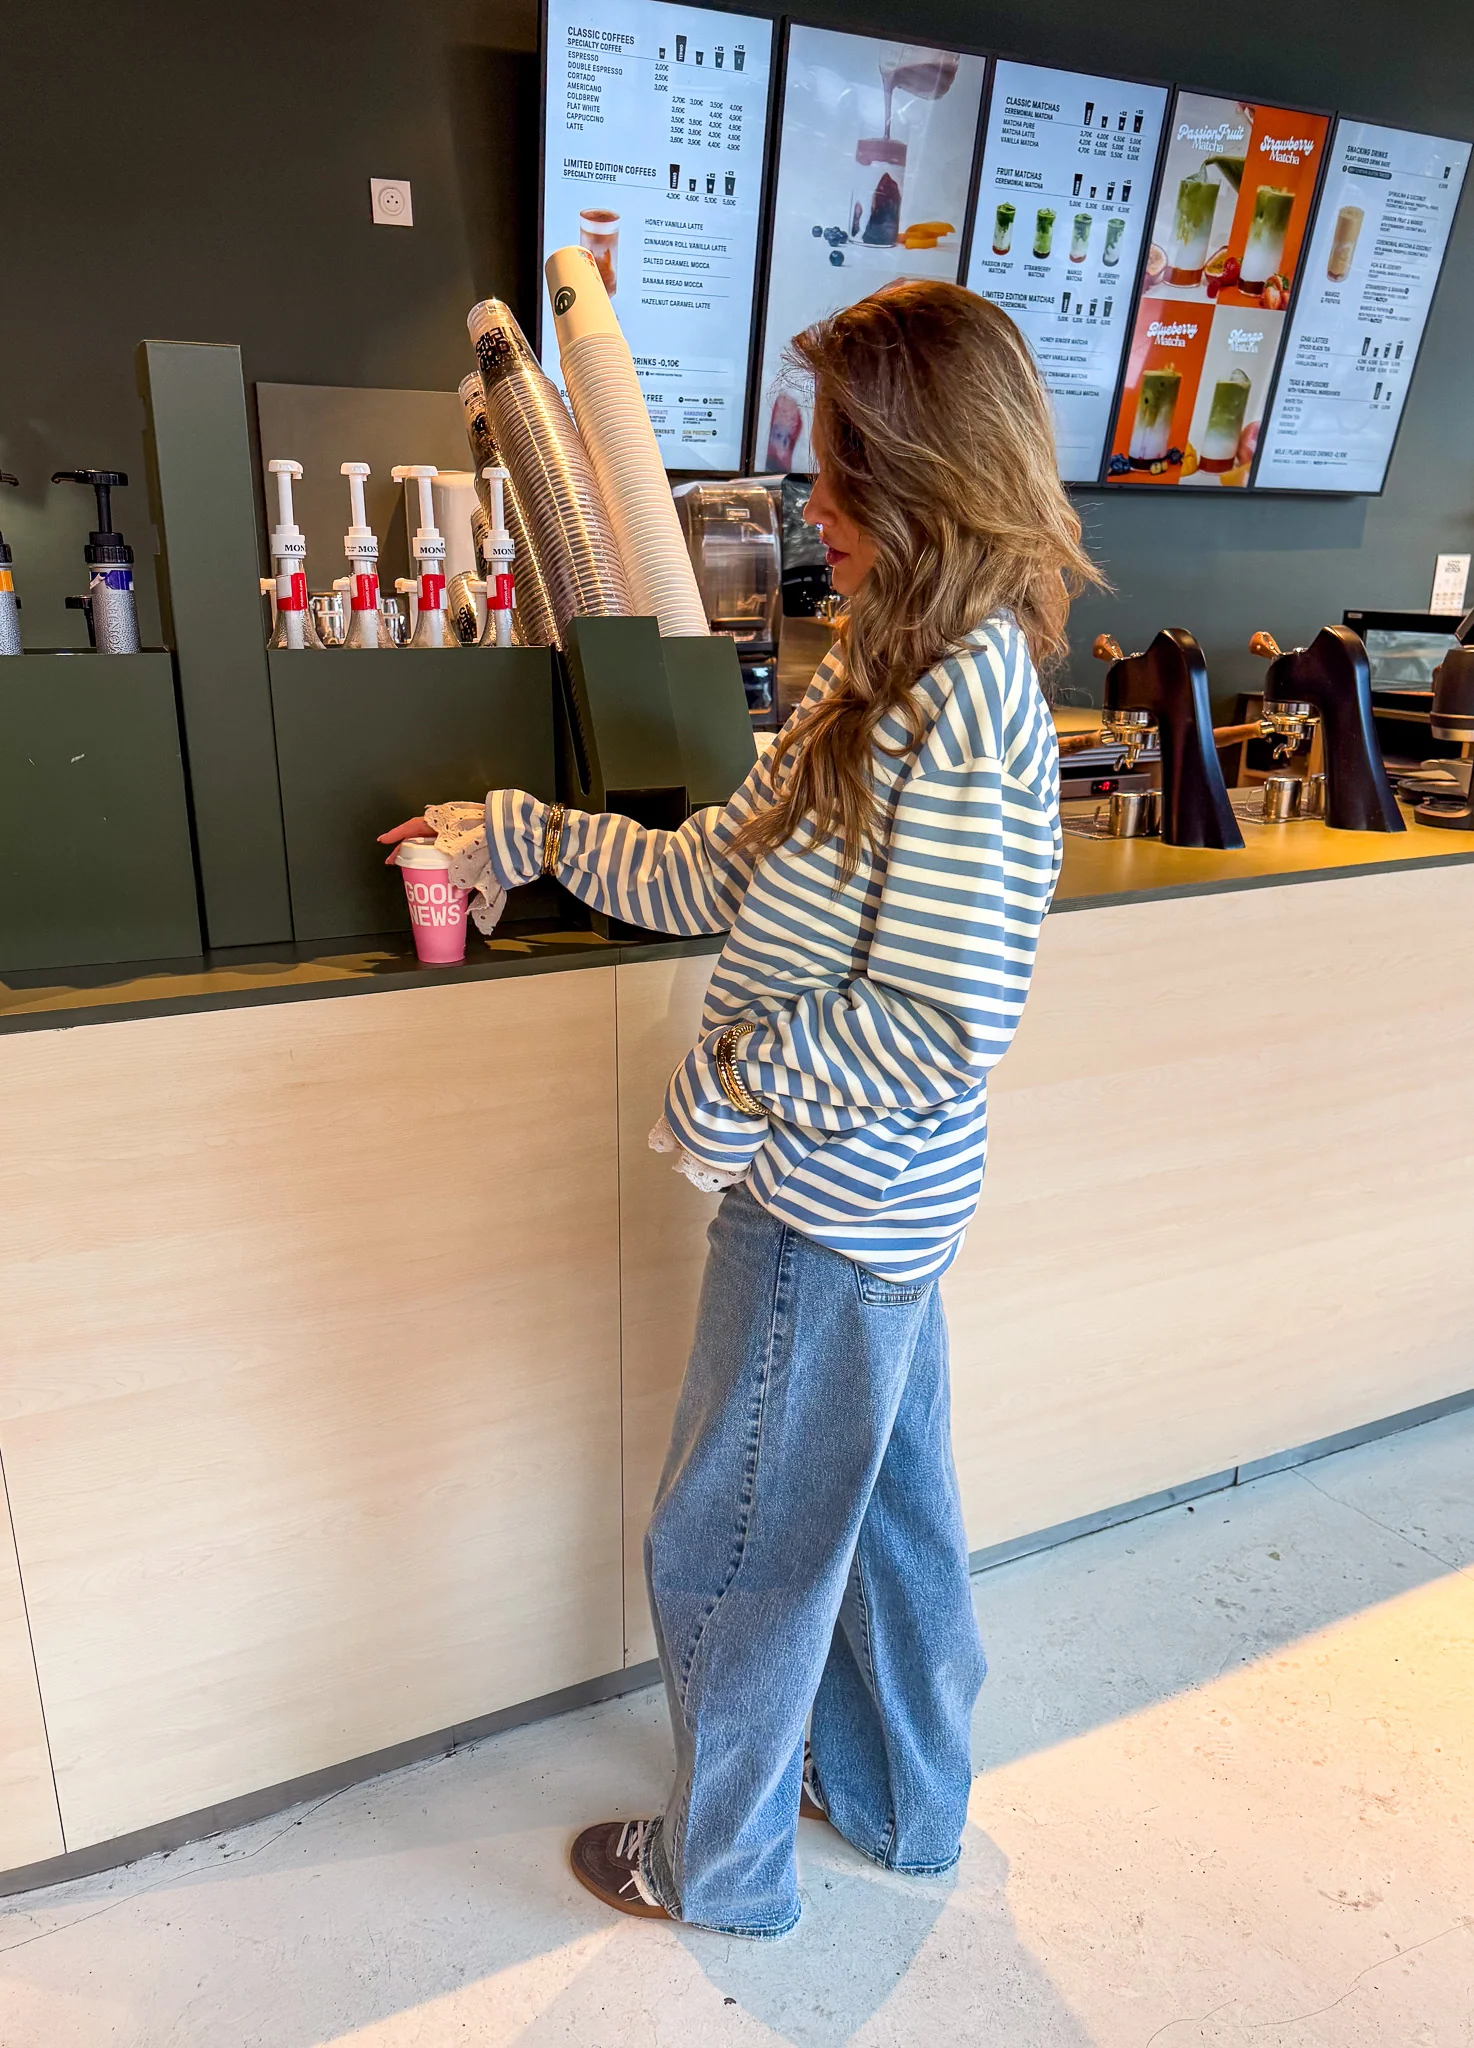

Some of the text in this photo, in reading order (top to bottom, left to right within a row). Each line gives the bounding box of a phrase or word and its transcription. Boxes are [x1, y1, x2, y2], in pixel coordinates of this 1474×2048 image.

[568, 26, 634, 45] CLASSIC COFFEES
[568, 38, 622, 53] SPECIALTY COFFEE
[568, 51, 599, 62] ESPRESSO
[568, 61, 591, 71] DOUBLE
[593, 65, 623, 76] ESPRESSO
[568, 71, 595, 82] CORTADO
[567, 82, 602, 93] AMERICANO
[567, 92, 600, 103] COLDBREW
[1006, 96, 1060, 112] CLASSIC MATCHAS
[567, 102, 580, 110] FLAT
[582, 104, 600, 113] WHITE
[1004, 107, 1053, 120] CEREMONIAL MATCHA
[567, 112, 604, 123] CAPPUCCINO
[1003, 119, 1022, 127] MATCHA
[1023, 121, 1035, 129] PURE
[567, 122, 584, 131] LATTE
[1002, 127, 1021, 135] MATCHA
[1001, 136, 1019, 144] VANILLA
[1020, 139, 1039, 147] MATCHA
[1192, 140, 1224, 153] Matcha
[1260, 135, 1314, 155] Strawberry
[1269, 150, 1300, 165] Matcha
[1347, 145, 1388, 159] SNACKING DRINKS
[563, 158, 657, 177] LIMITED EDITION COFFEES
[996, 167, 1042, 180] FRUIT MATCHAS
[563, 169, 616, 182] SPECIALTY COFFEE
[995, 177, 1043, 189] CEREMONIAL MATCHA
[645, 219, 703, 231] HONEY VANILLA LATTE
[644, 238, 727, 252] CINNAMON ROLL VANILLA LATTE
[643, 257, 710, 269] SALTED CARAMEL MOCCA
[642, 277, 664, 285] BANANA
[665, 279, 683, 287] BREAD
[642, 298, 668, 306] HAZELNUT
[670, 300, 694, 308] CARAMEL
[982, 290, 1055, 304] LIMITED EDITION MATCHAS
[1147, 321, 1198, 339] Blueberry
[1154, 335, 1186, 348] Matcha
[1228, 328, 1264, 346] Mango
[1229, 341, 1259, 353] Matcha
[647, 394, 663, 402] FREE
[409, 904, 460, 927] NEWS
